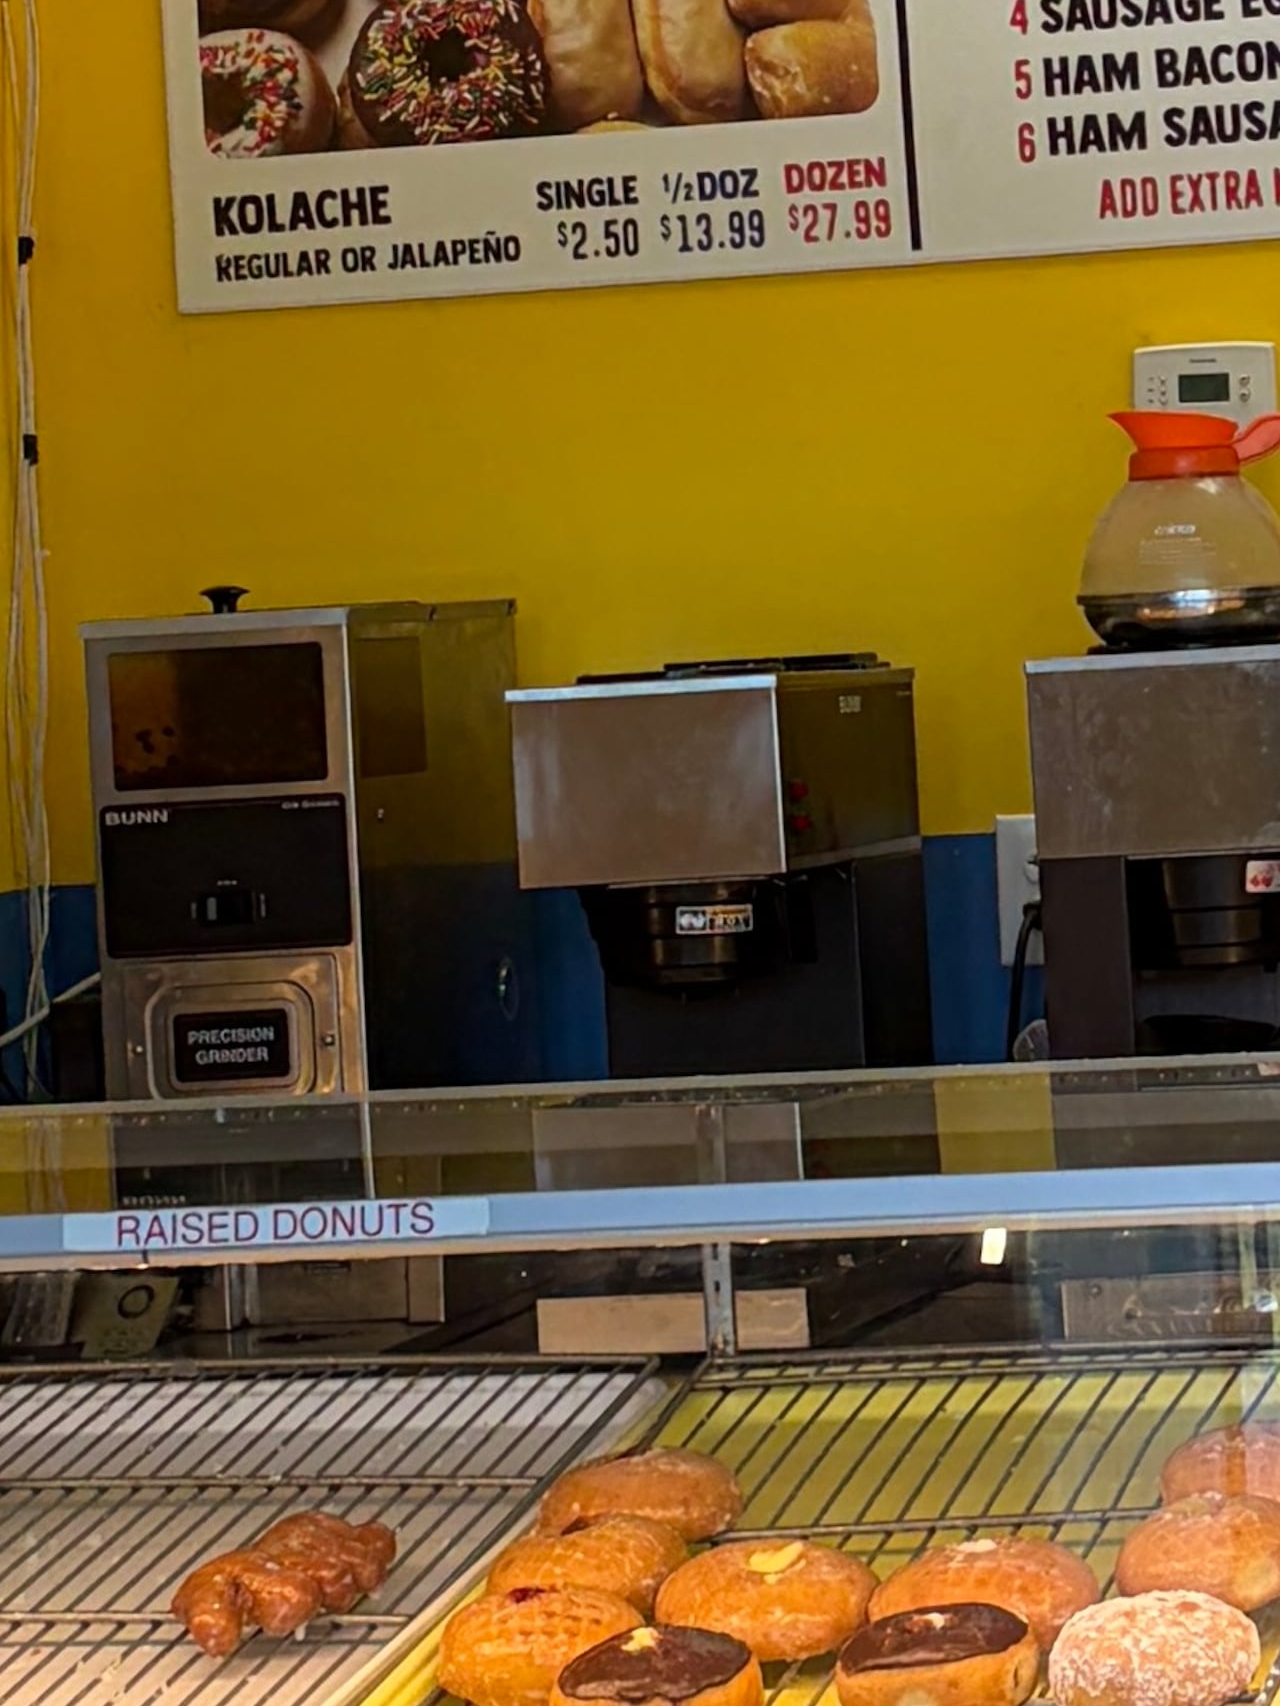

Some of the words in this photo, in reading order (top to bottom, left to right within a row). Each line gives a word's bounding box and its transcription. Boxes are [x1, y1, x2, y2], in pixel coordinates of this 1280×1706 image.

[1043, 52, 1140, 97] HAM
[1047, 111, 1147, 156] HAM
[536, 175, 639, 211] SINGLE
[784, 157, 886, 194] DOZEN
[1100, 177, 1158, 219] ADD
[1170, 169, 1263, 214] EXTRA
[213, 185, 392, 237] KOLACHE
[215, 249, 331, 282] REGULAR
[342, 246, 376, 273] OR
[388, 231, 521, 270] JALAPEÑO
[557, 218, 639, 259] $2.50
[660, 209, 765, 252] $13.99
[789, 199, 891, 243] $27.99
[105, 809, 168, 825] BUNN
[188, 1027, 274, 1044] PRECISION
[196, 1047, 268, 1064] GRINDER
[118, 1210, 259, 1247] RAISED
[273, 1201, 434, 1240] DONUTS
